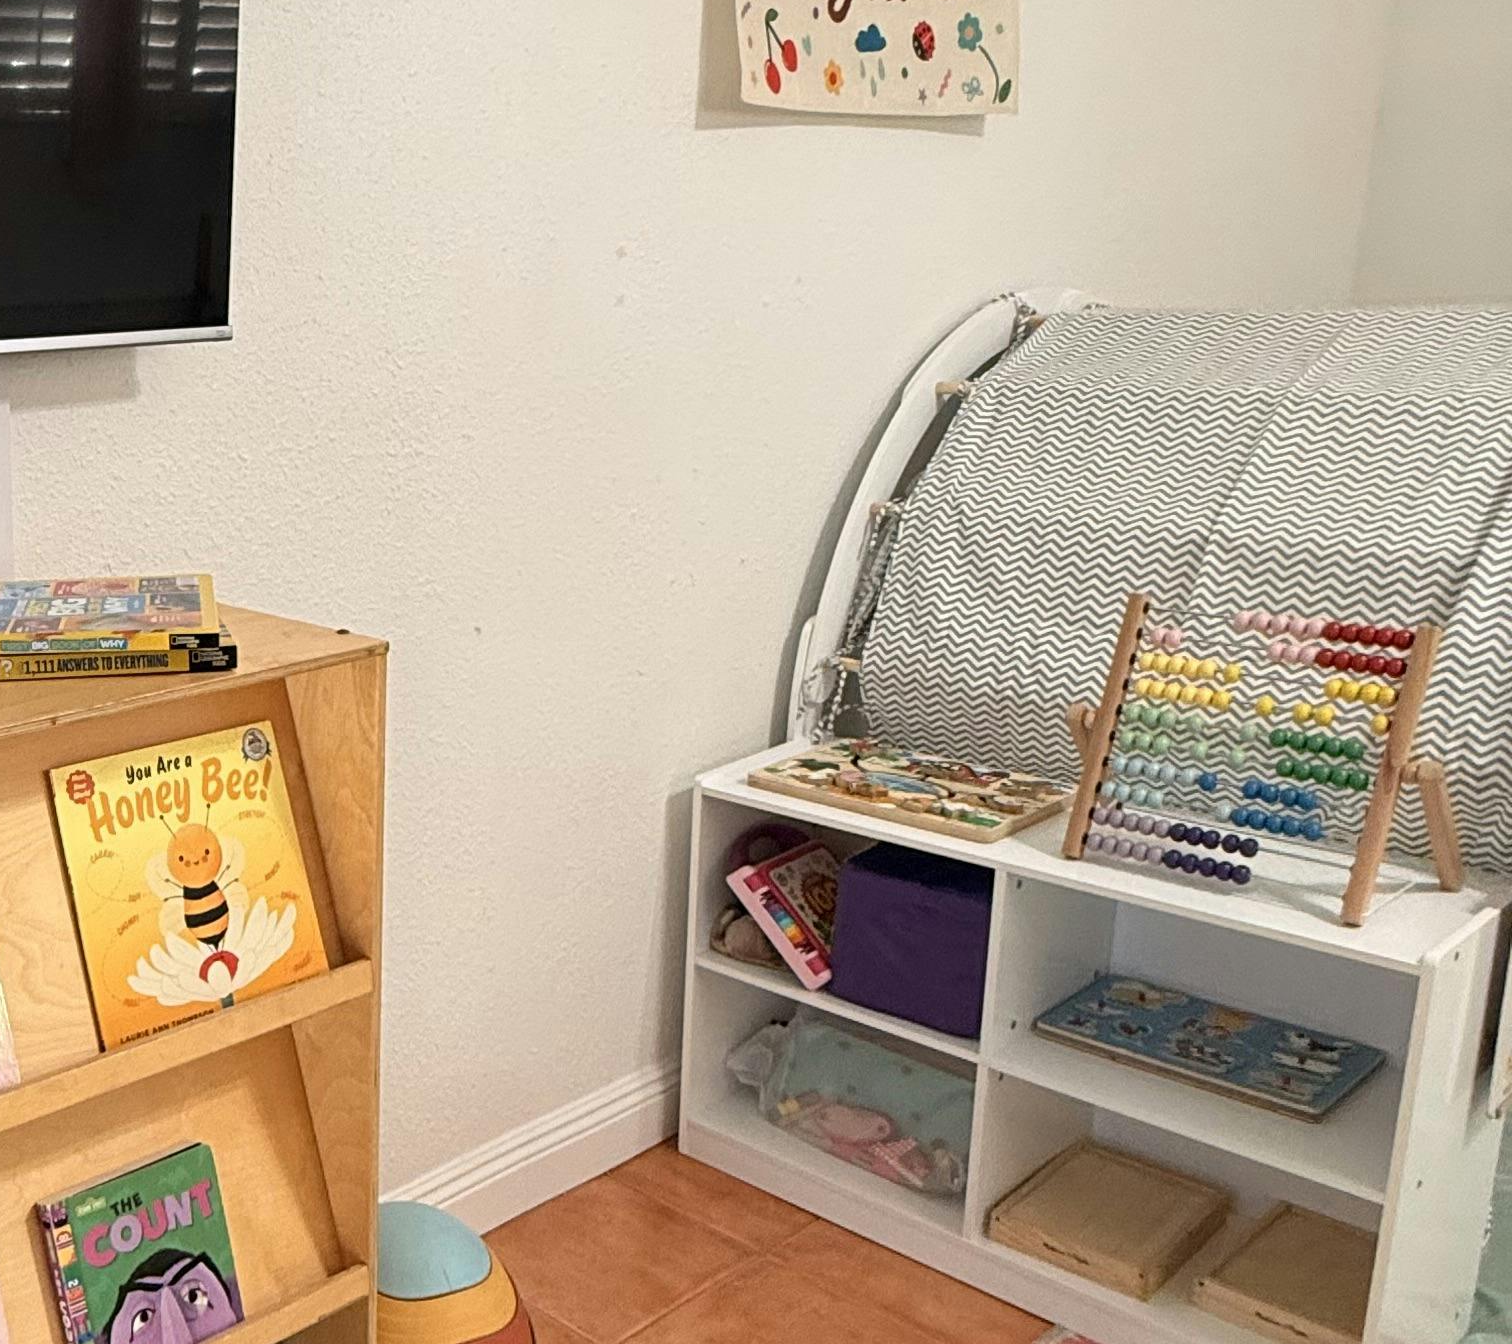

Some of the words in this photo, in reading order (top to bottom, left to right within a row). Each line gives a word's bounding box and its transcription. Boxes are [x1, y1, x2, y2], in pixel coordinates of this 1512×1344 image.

[30, 639, 49, 650] BIG
[99, 636, 126, 649] WHY
[24, 660, 56, 676] 1,111
[56, 657, 99, 673] ANSWERS
[100, 656, 112, 670] TO
[113, 653, 169, 670] EVERYTHING
[125, 763, 152, 785] You
[156, 756, 180, 773] Are
[184, 756, 192, 767] a
[86, 777, 191, 843] Honey
[200, 757, 273, 803] Bee!
[119, 1029, 150, 1044] LAURIE
[151, 1022, 169, 1034] ANN
[109, 1192, 144, 1216] THE
[82, 1178, 214, 1268] COUNT
